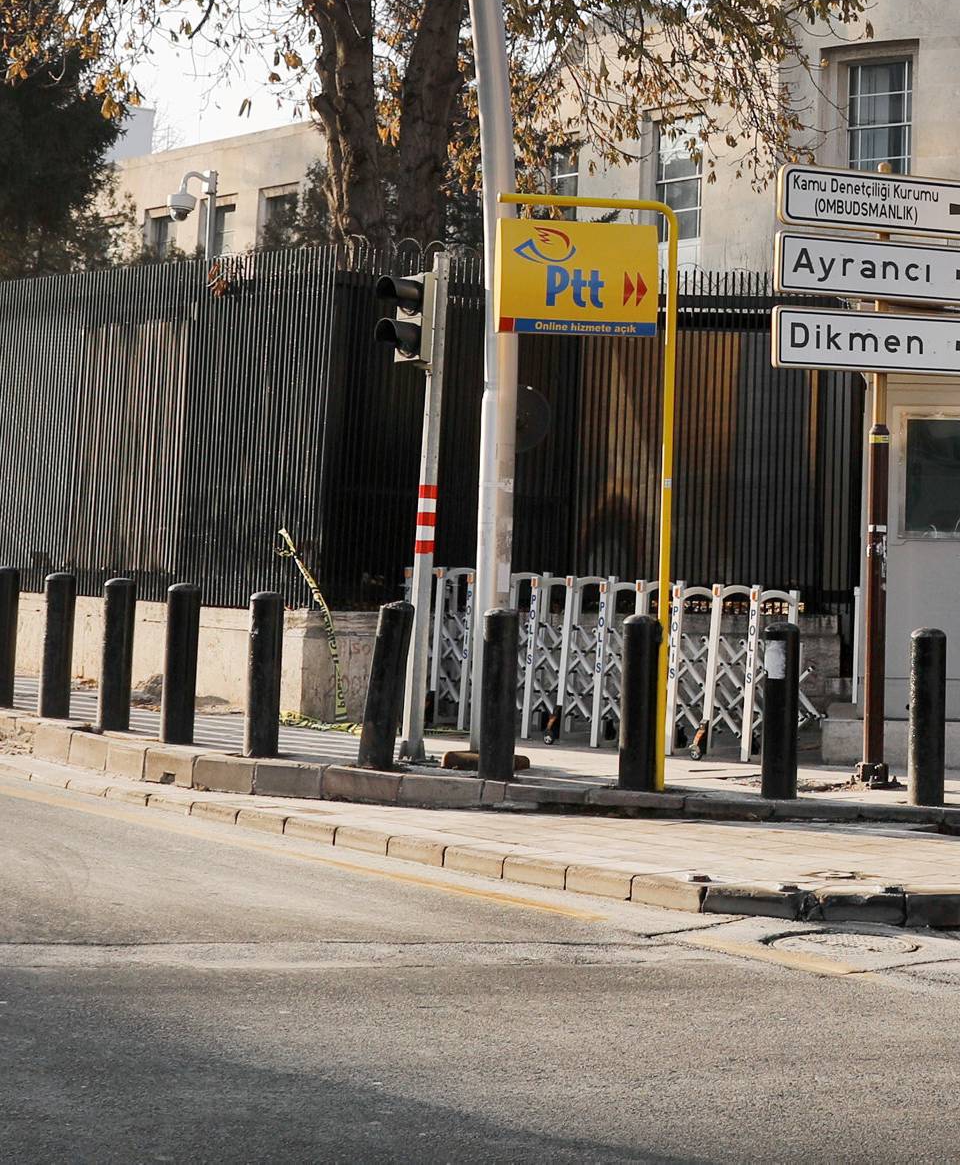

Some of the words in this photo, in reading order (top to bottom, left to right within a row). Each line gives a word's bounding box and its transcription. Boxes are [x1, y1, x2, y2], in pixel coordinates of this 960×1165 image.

[793, 174, 827, 193] Kamu
[831, 178, 890, 202] Denetçiliği
[893, 184, 939, 203] Kurumu
[814, 198, 918, 226] (OMBUDSMANLIK)
[792, 247, 931, 283] Ayrancı
[545, 264, 605, 309] Ptt
[535, 320, 568, 332] Online
[570, 322, 612, 333] hizmete
[614, 323, 637, 335] açık
[790, 321, 924, 355] Dikmen
[527, 594, 537, 666] POLİS
[596, 601, 605, 674] POLİS
[669, 605, 679, 680] POLİS
[746, 609, 756, 684] POLİS
